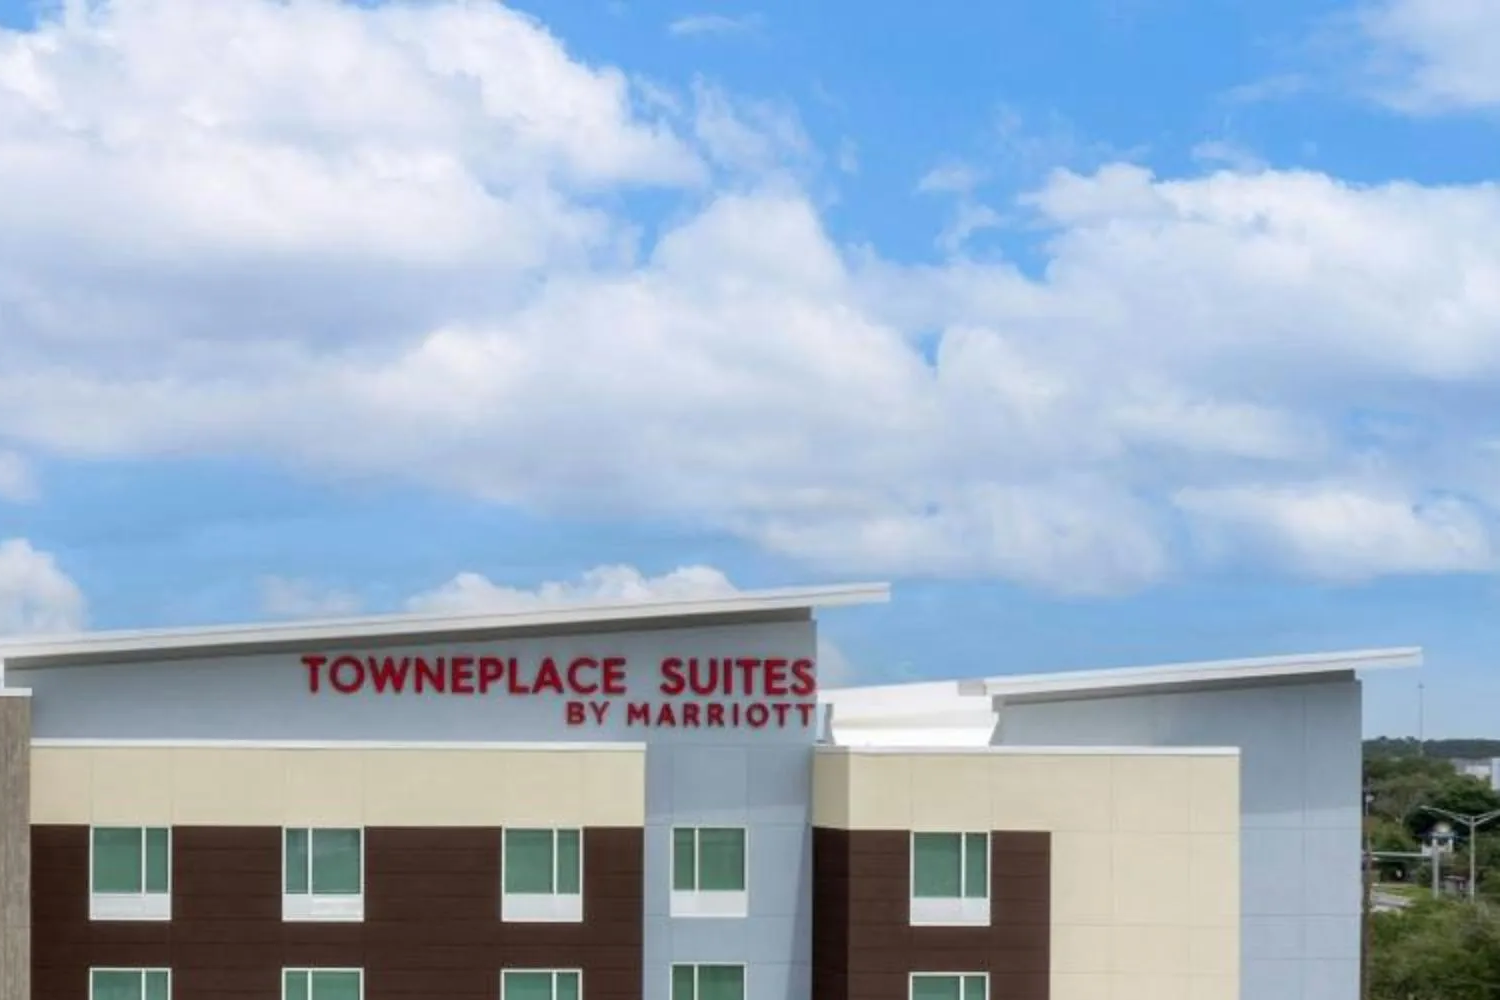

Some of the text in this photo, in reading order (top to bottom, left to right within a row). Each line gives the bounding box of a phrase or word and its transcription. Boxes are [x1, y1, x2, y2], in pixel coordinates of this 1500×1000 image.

[301, 656, 816, 696] TOWNEPLACE SUITES
[566, 701, 815, 727] BY MARRIOTT
